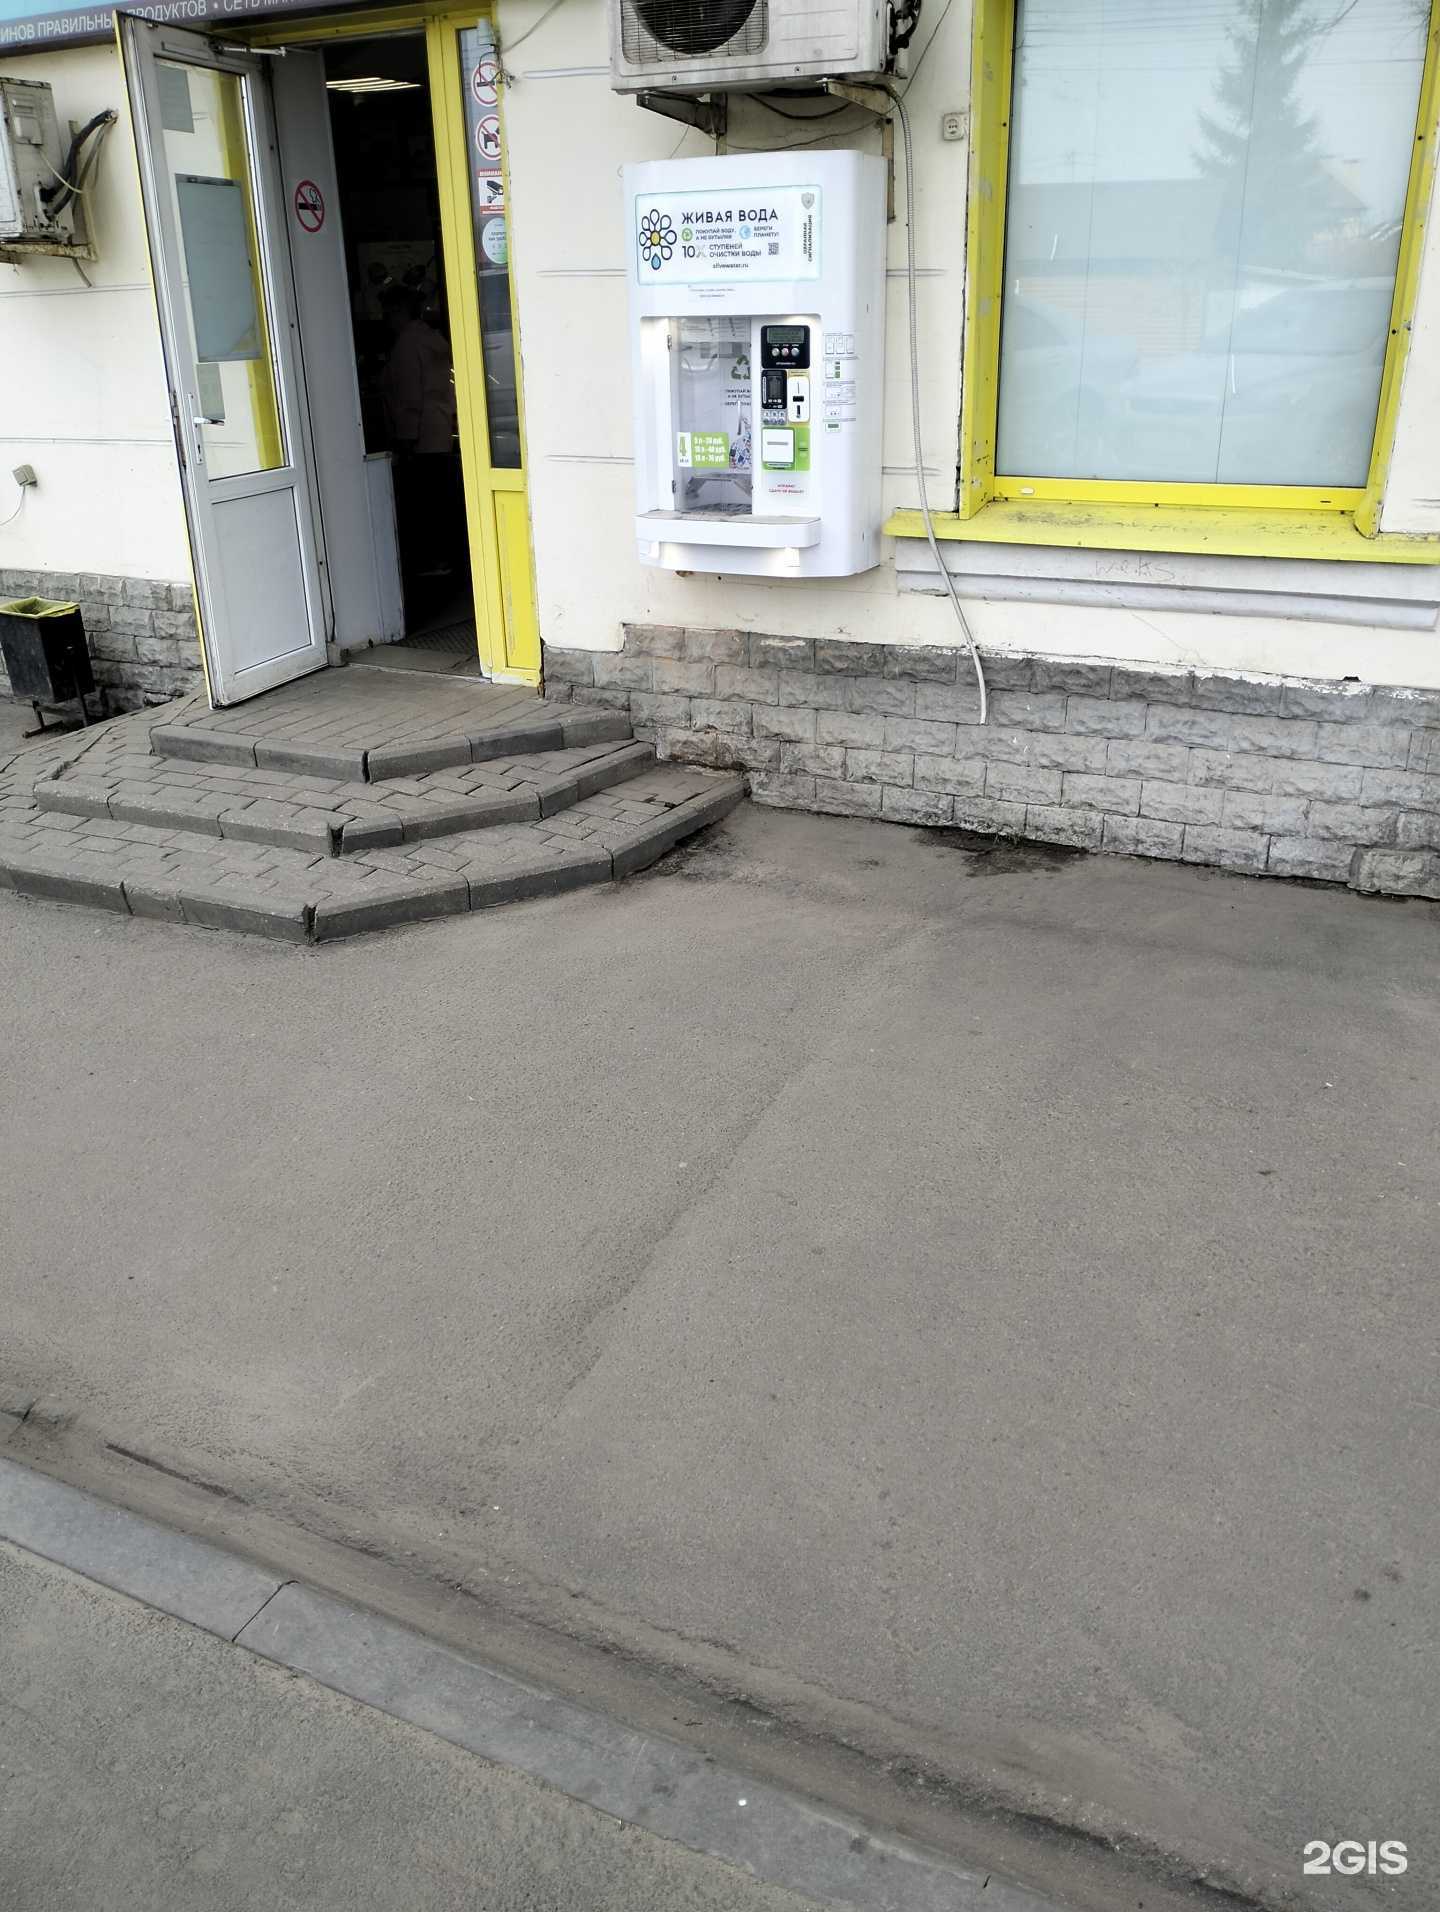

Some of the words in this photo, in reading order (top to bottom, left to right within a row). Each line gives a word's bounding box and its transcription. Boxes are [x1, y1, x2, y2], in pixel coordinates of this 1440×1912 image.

[681, 210, 733, 224] ЖИВАЯ
[738, 208, 778, 223] ВОДА
[709, 250, 740, 258] ОЧИСТКИ
